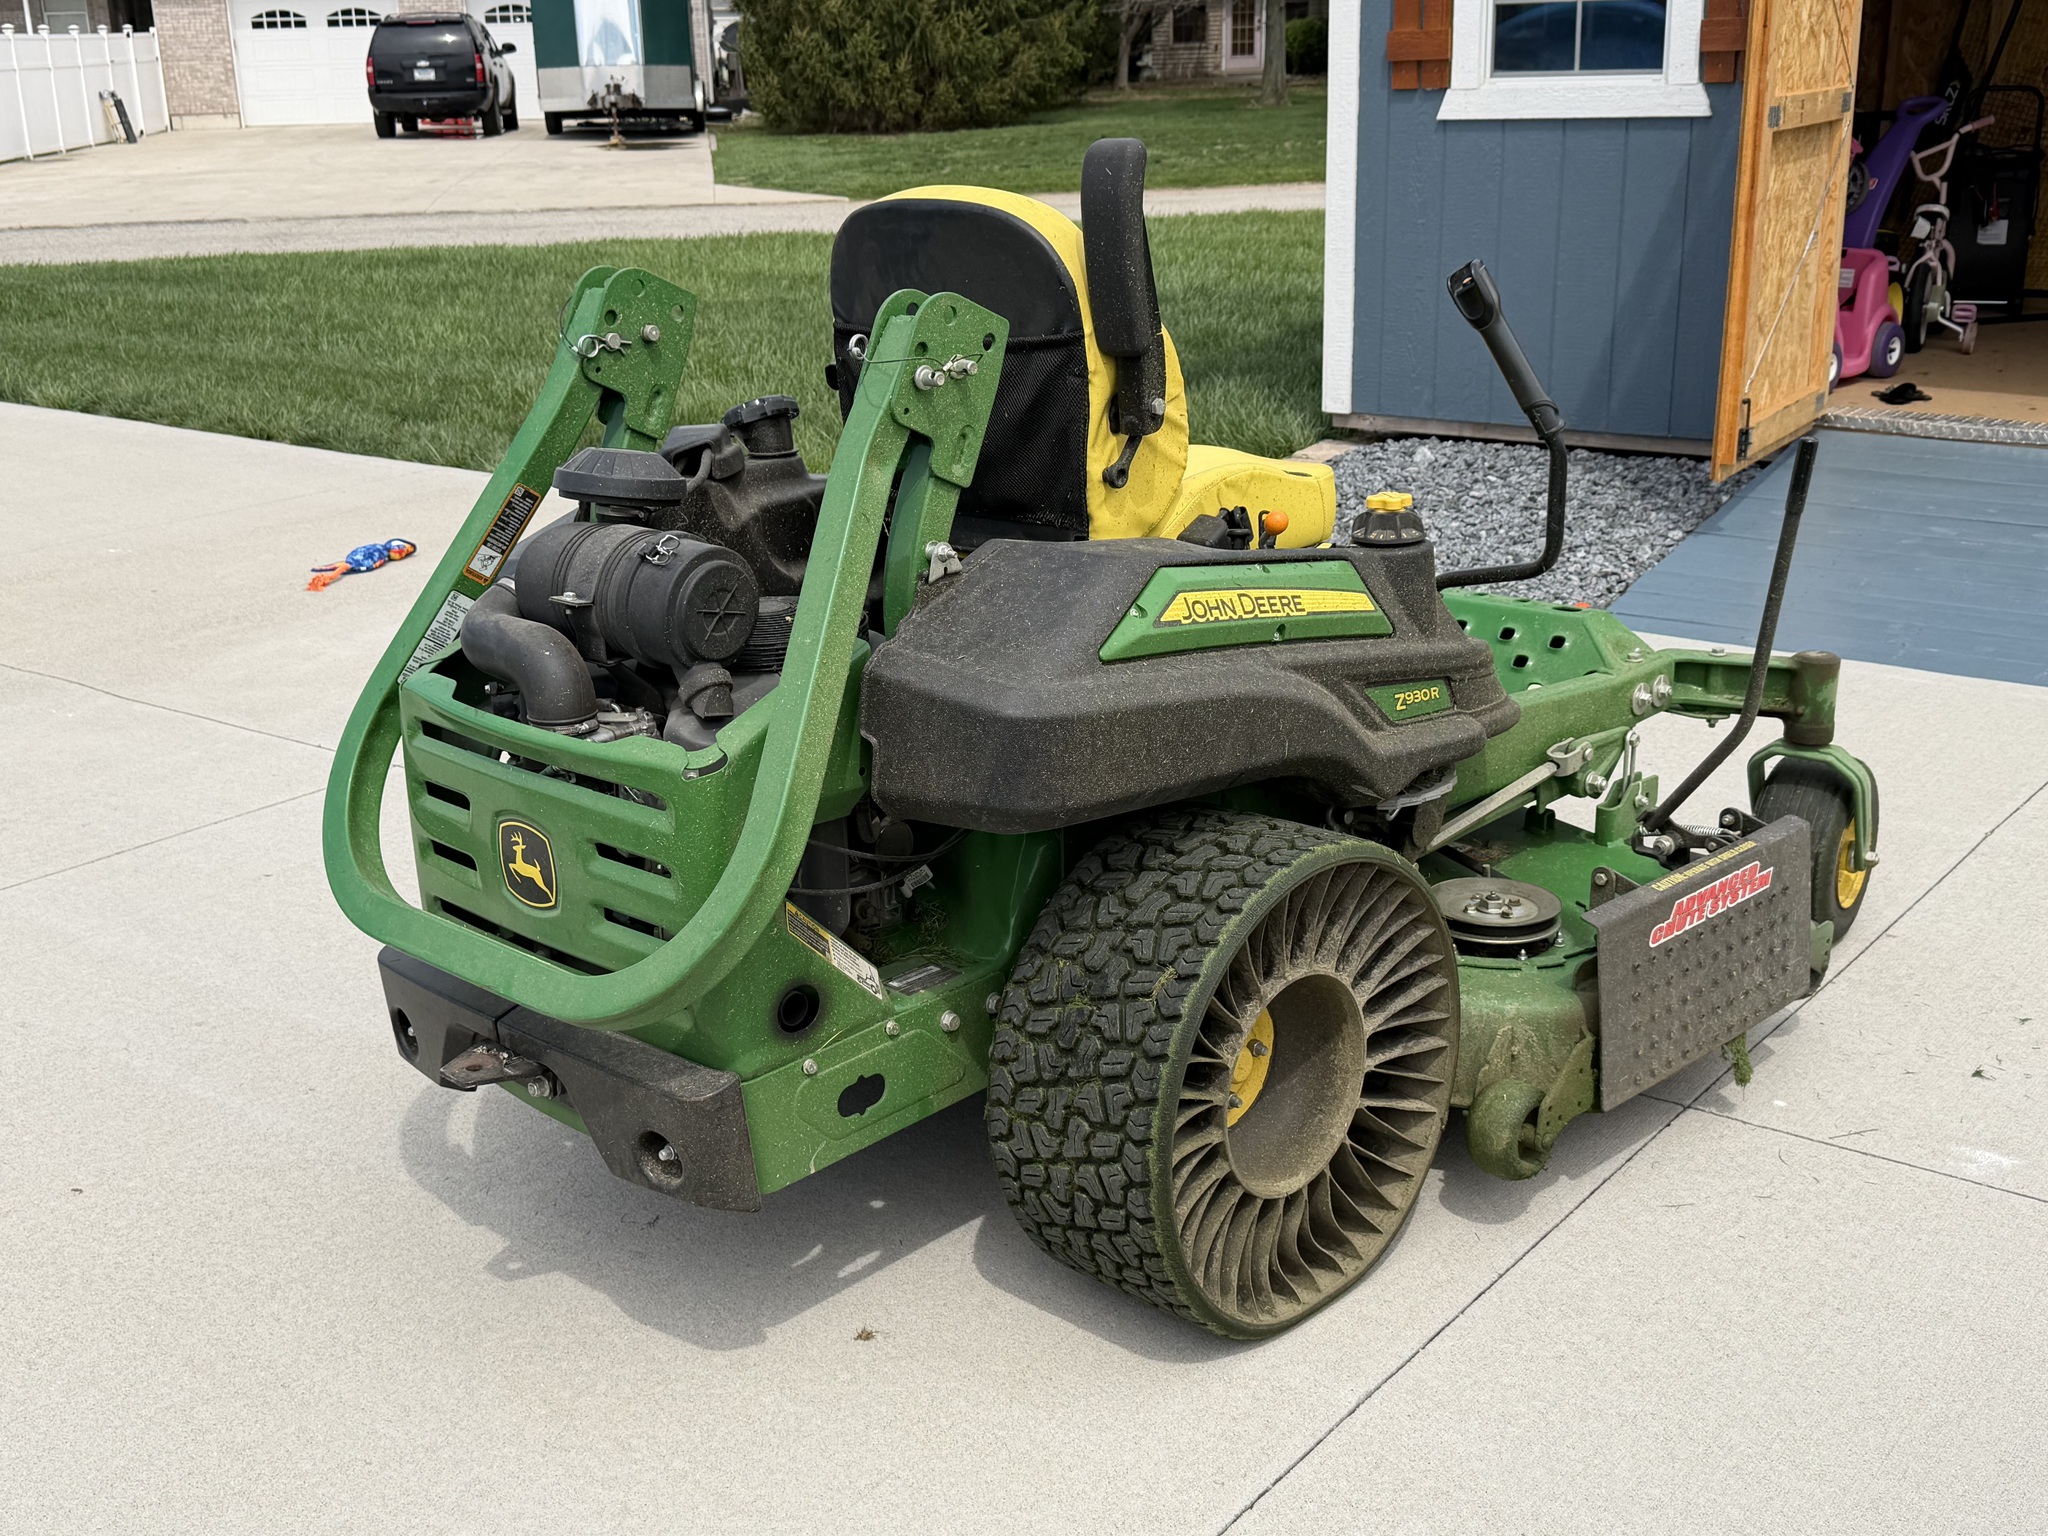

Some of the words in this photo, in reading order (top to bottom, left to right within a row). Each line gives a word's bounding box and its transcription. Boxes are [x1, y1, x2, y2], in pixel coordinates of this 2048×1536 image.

[1182, 596, 1238, 621] JOHN
[1237, 592, 1306, 616] DEERE
[1394, 686, 1440, 711] Z930R
[1650, 905, 1707, 946] CHUTE
[1708, 869, 1773, 916] SYSTEM
[1672, 862, 1760, 917] ADVANCED
